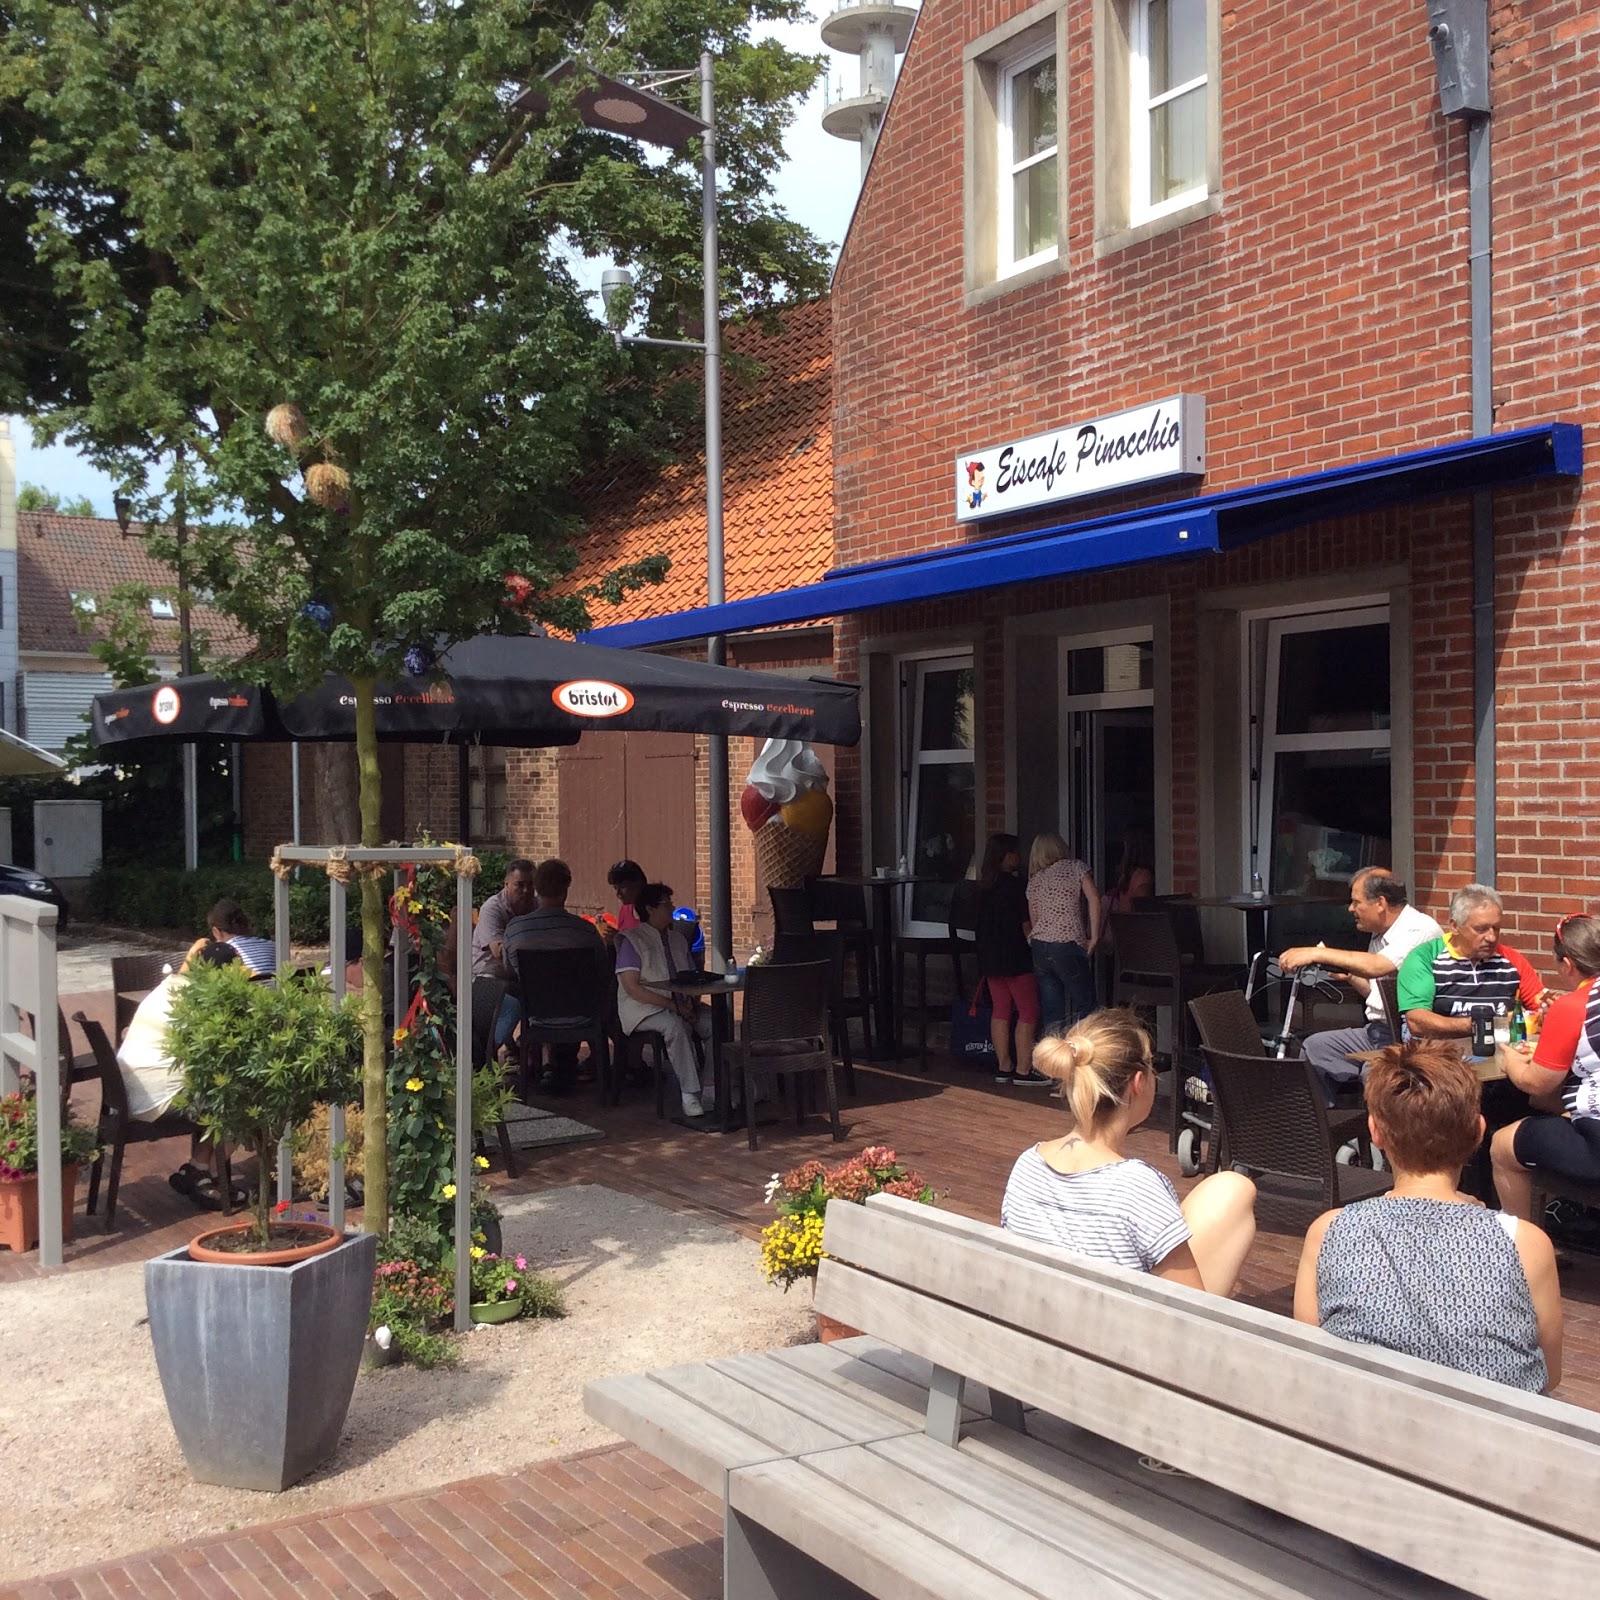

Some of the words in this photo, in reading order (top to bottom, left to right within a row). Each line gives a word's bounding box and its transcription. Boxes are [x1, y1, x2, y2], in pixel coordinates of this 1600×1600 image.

[996, 437, 1066, 493] Eiscafe
[1076, 409, 1180, 473] Pinocchio
[339, 695, 391, 709] essso
[395, 692, 455, 704] eccelle
[568, 690, 619, 707] bristot
[721, 699, 764, 712] espresso
